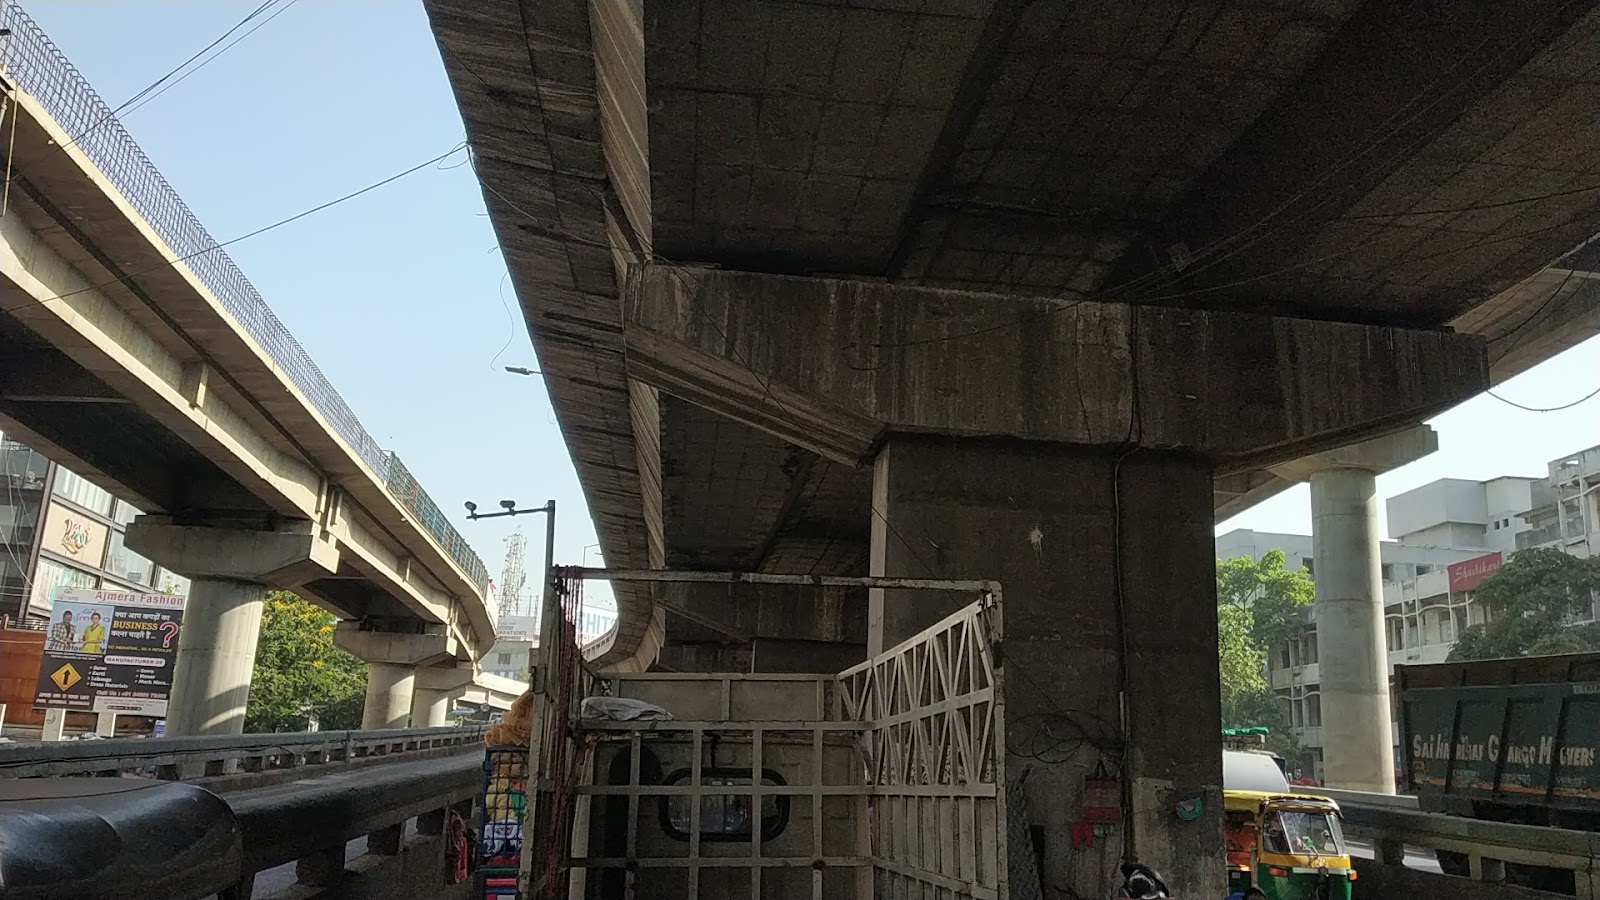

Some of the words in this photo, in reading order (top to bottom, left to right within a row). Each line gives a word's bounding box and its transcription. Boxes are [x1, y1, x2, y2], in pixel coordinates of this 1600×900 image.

[95, 591, 135, 603] Ajmera
[140, 593, 183, 605] Fashion
[113, 620, 158, 631] BUSINESS
[106, 657, 154, 665] MANUFACTURER
